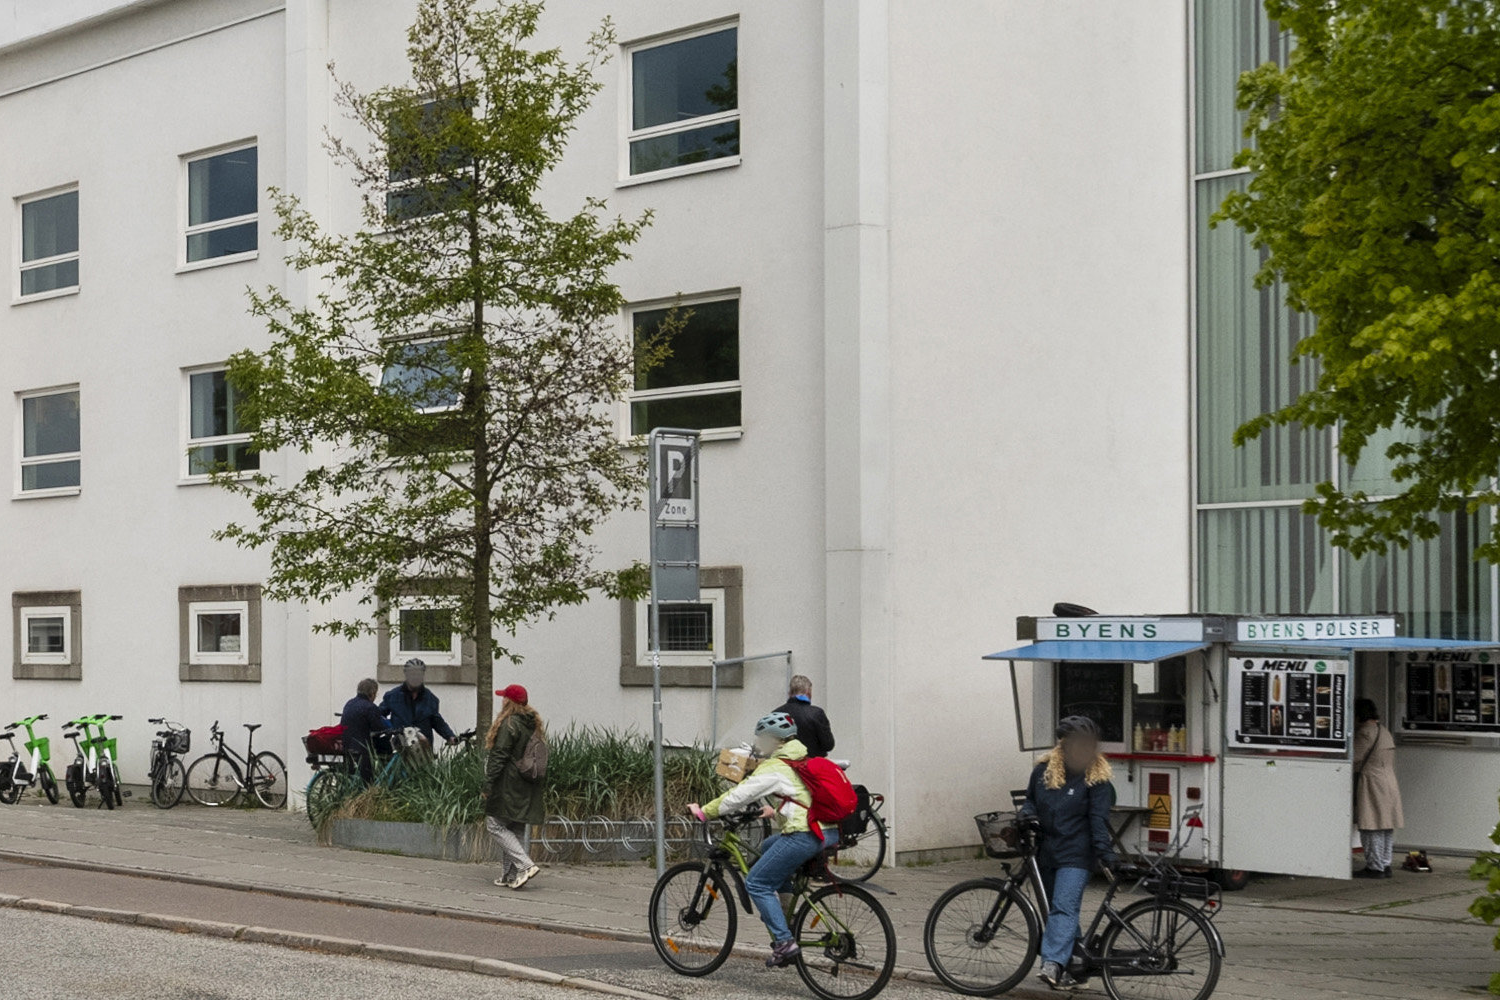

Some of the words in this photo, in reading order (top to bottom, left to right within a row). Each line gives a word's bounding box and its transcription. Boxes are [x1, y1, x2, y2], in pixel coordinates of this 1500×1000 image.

[667, 450, 686, 494] P
[665, 502, 687, 515] Zone
[1056, 623, 1157, 639] BYENS
[1247, 622, 1306, 639] BYENS
[1315, 620, 1381, 637] PØLSER
[1261, 660, 1308, 672] MENU
